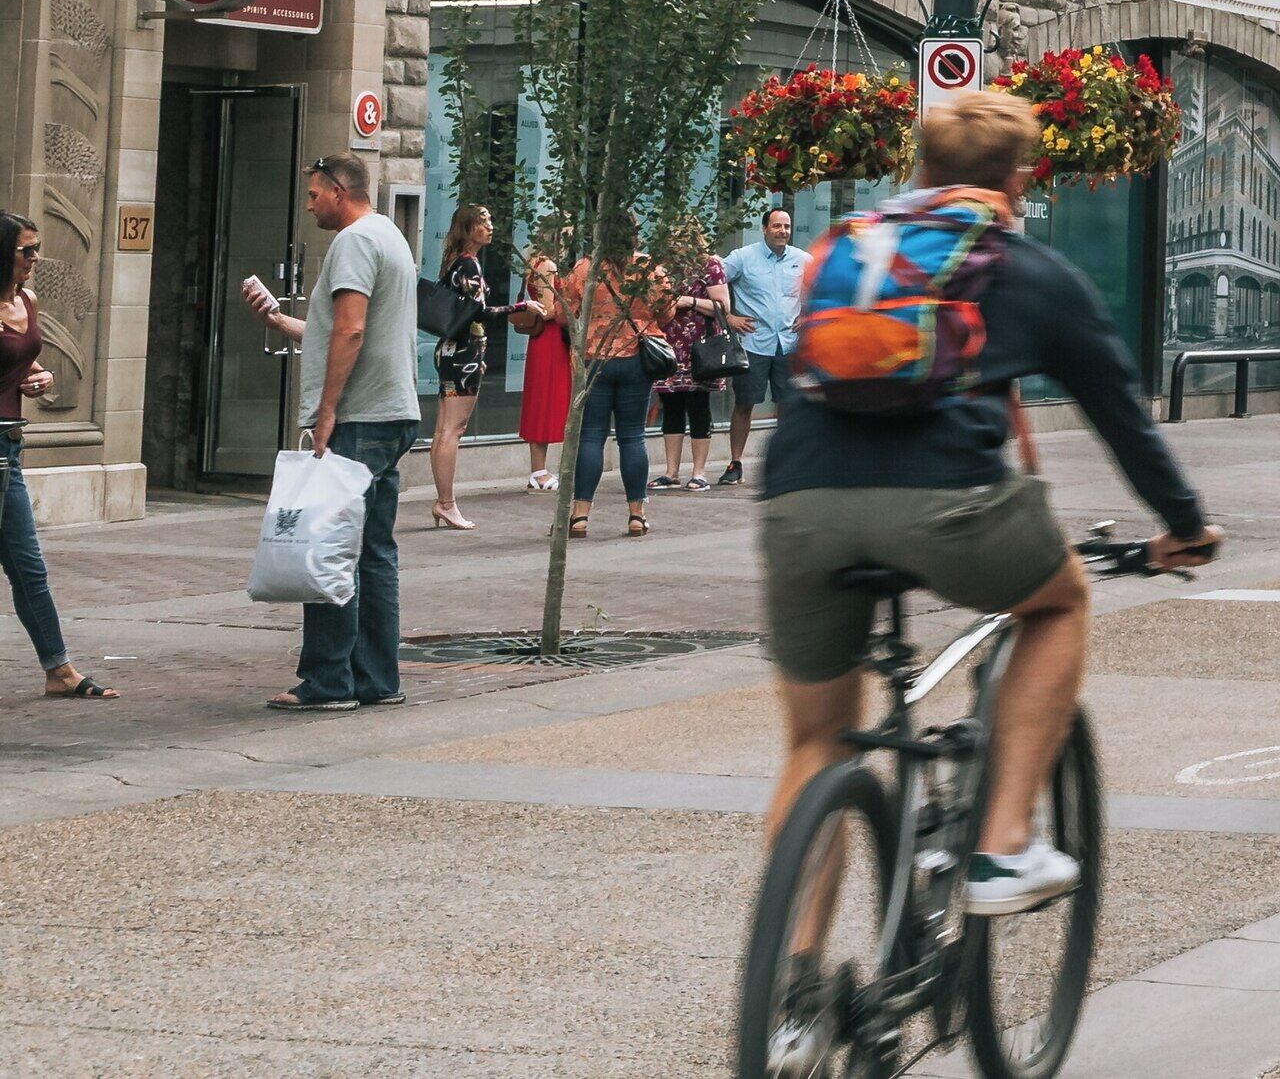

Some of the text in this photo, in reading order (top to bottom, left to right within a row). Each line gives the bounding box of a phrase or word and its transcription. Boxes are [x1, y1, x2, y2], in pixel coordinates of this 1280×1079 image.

[272, 8, 314, 21] ACCESSORIES
[364, 101, 377, 125] &
[122, 217, 149, 240] 137
